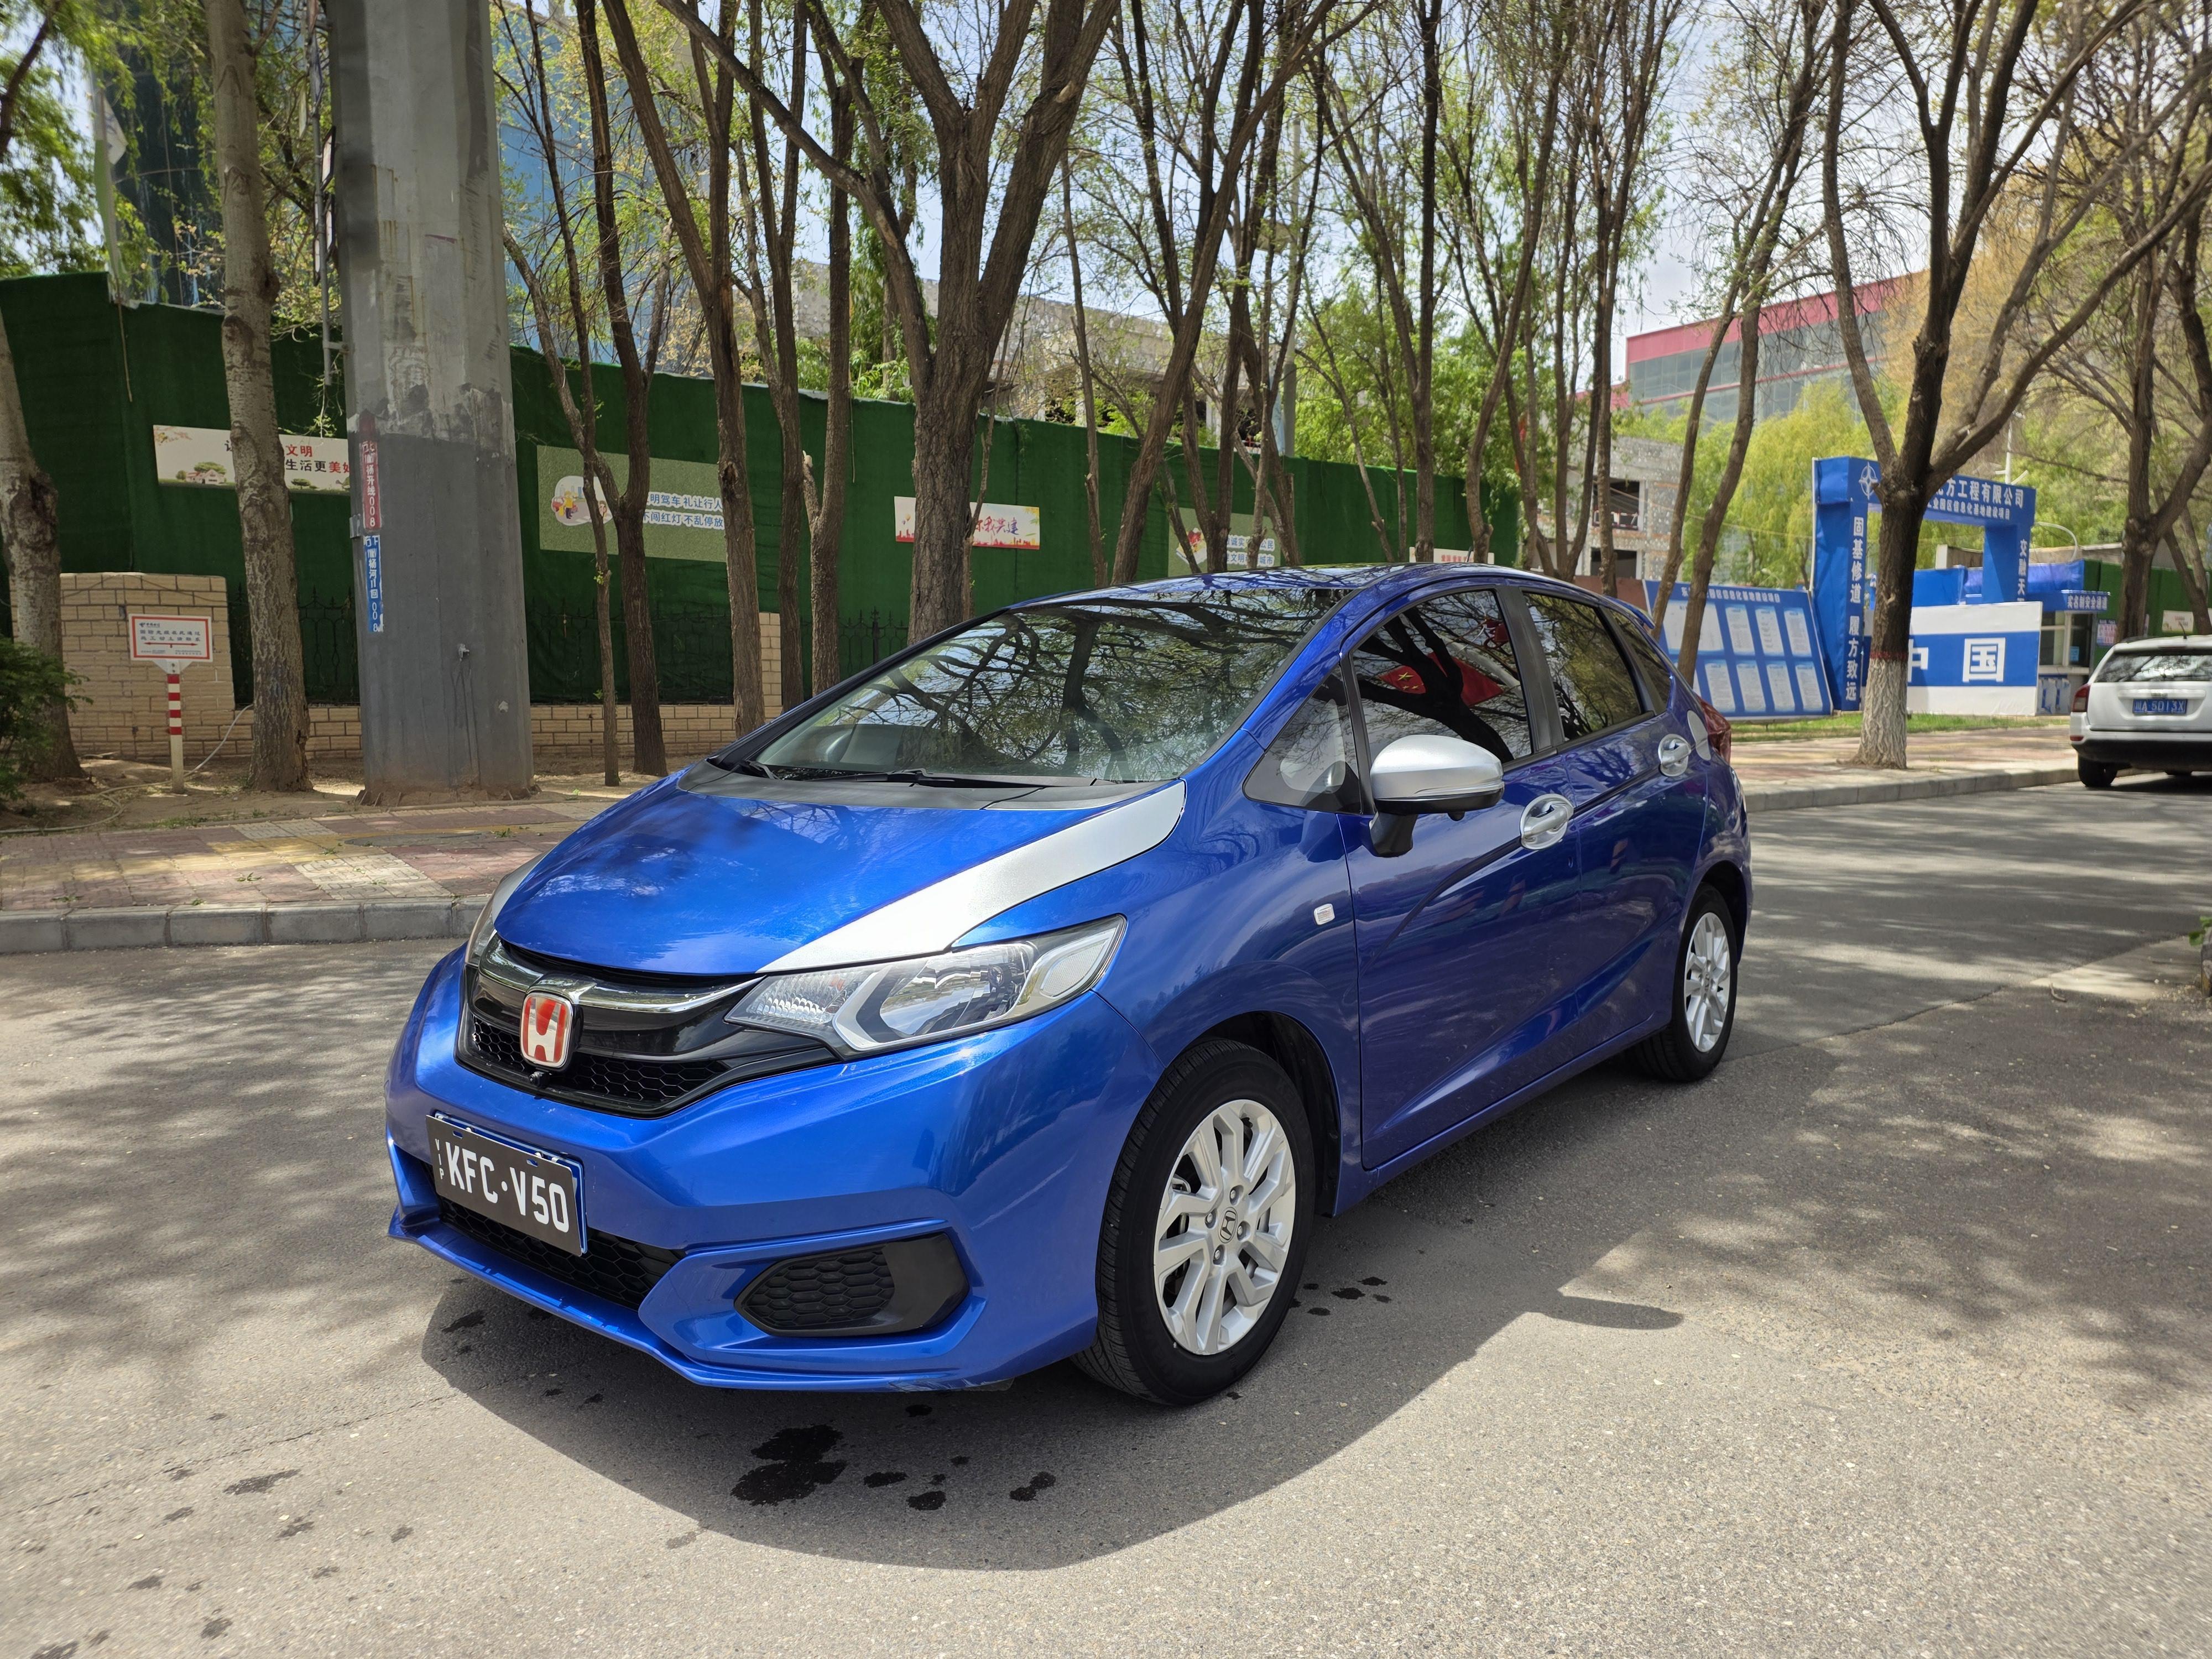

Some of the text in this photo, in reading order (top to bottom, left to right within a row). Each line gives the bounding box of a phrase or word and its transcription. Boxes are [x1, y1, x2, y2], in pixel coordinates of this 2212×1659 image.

[285, 444, 312, 457] 文明
[647, 494, 722, 509] 明驾车 礼让行人
[1936, 478, 2024, 509] 方工程有限公司
[684, 515, 723, 527] 不乱停放
[1846, 517, 1864, 701] 固基修道 履方致远
[435, 1139, 444, 1180] VIP
[446, 1141, 569, 1233] KFC·V50
